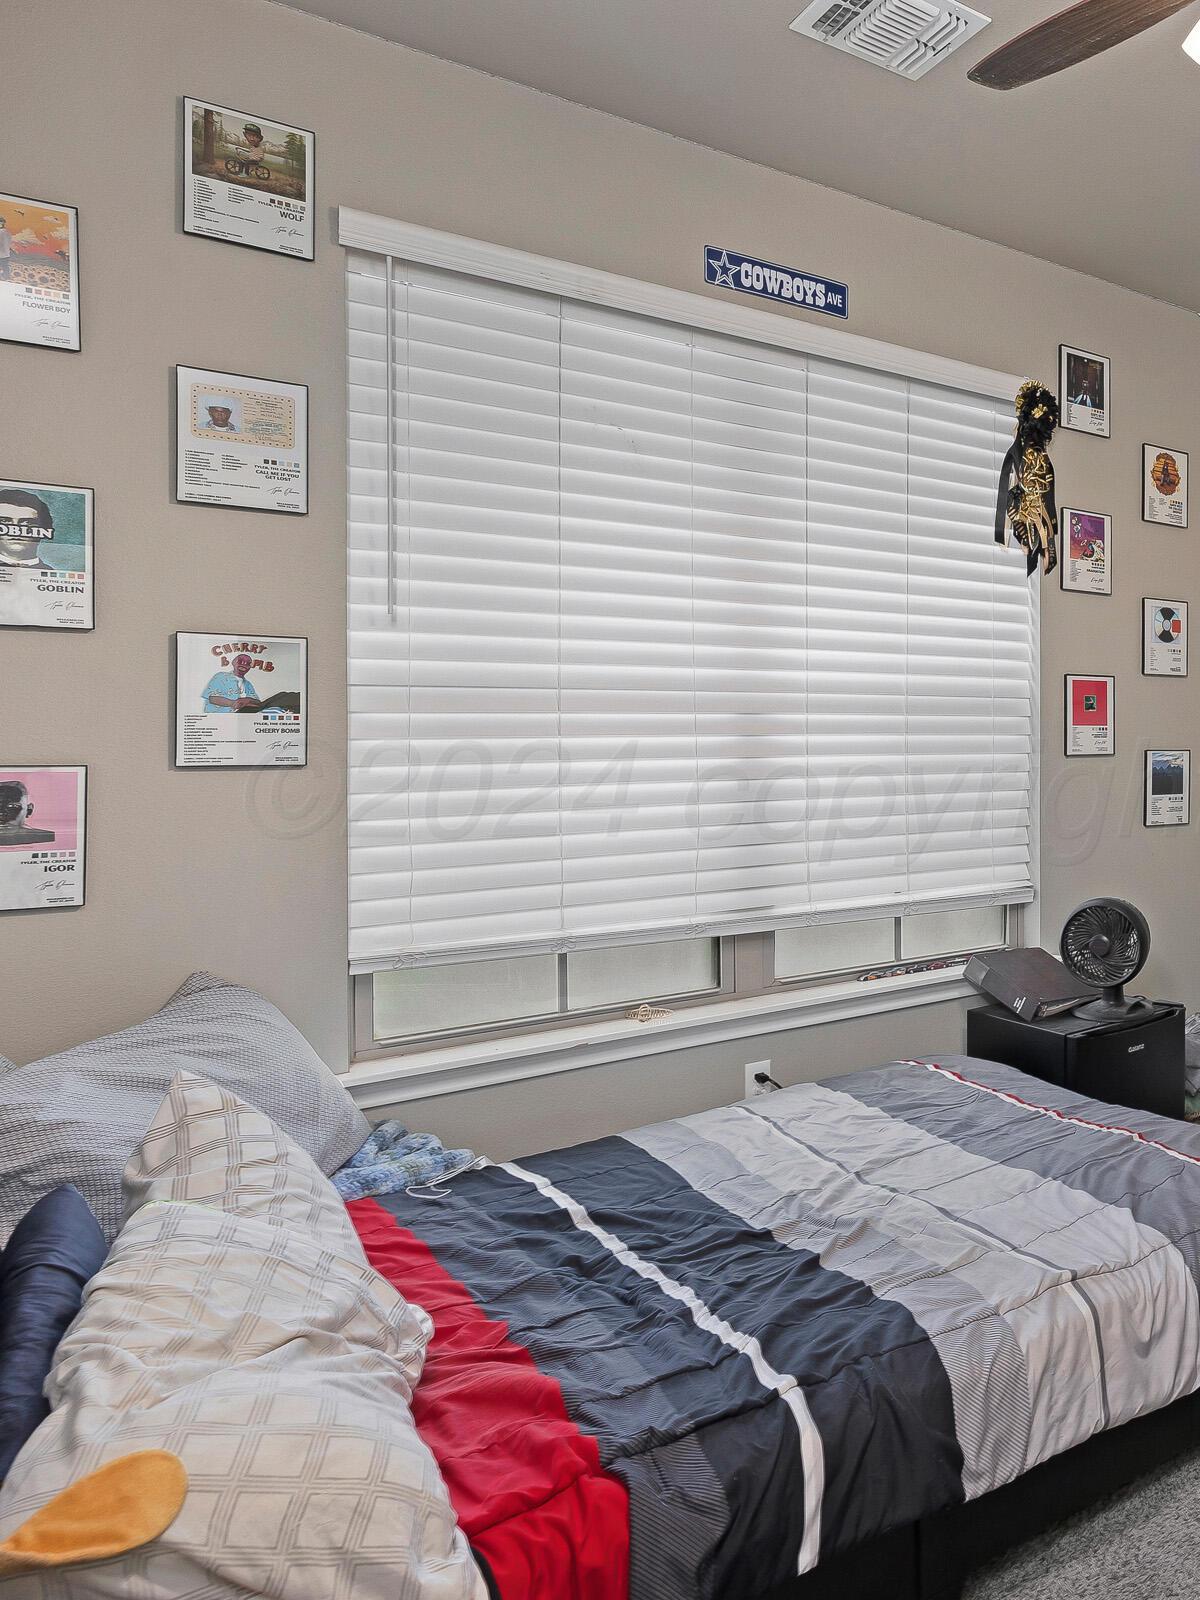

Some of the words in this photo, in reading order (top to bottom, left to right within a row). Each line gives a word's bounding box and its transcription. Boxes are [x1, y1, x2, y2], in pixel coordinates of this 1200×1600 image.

[280, 211, 304, 222] WOLF
[740, 262, 826, 307] COWBOYS
[827, 292, 842, 307] AVE
[23, 301, 54, 311] FLOWER
[0, 525, 54, 538] OBLIN
[37, 584, 84, 593] GOBLIN
[211, 642, 268, 656] CHERRY
[221, 656, 275, 672] BMB
[44, 864, 75, 872] IGOR
